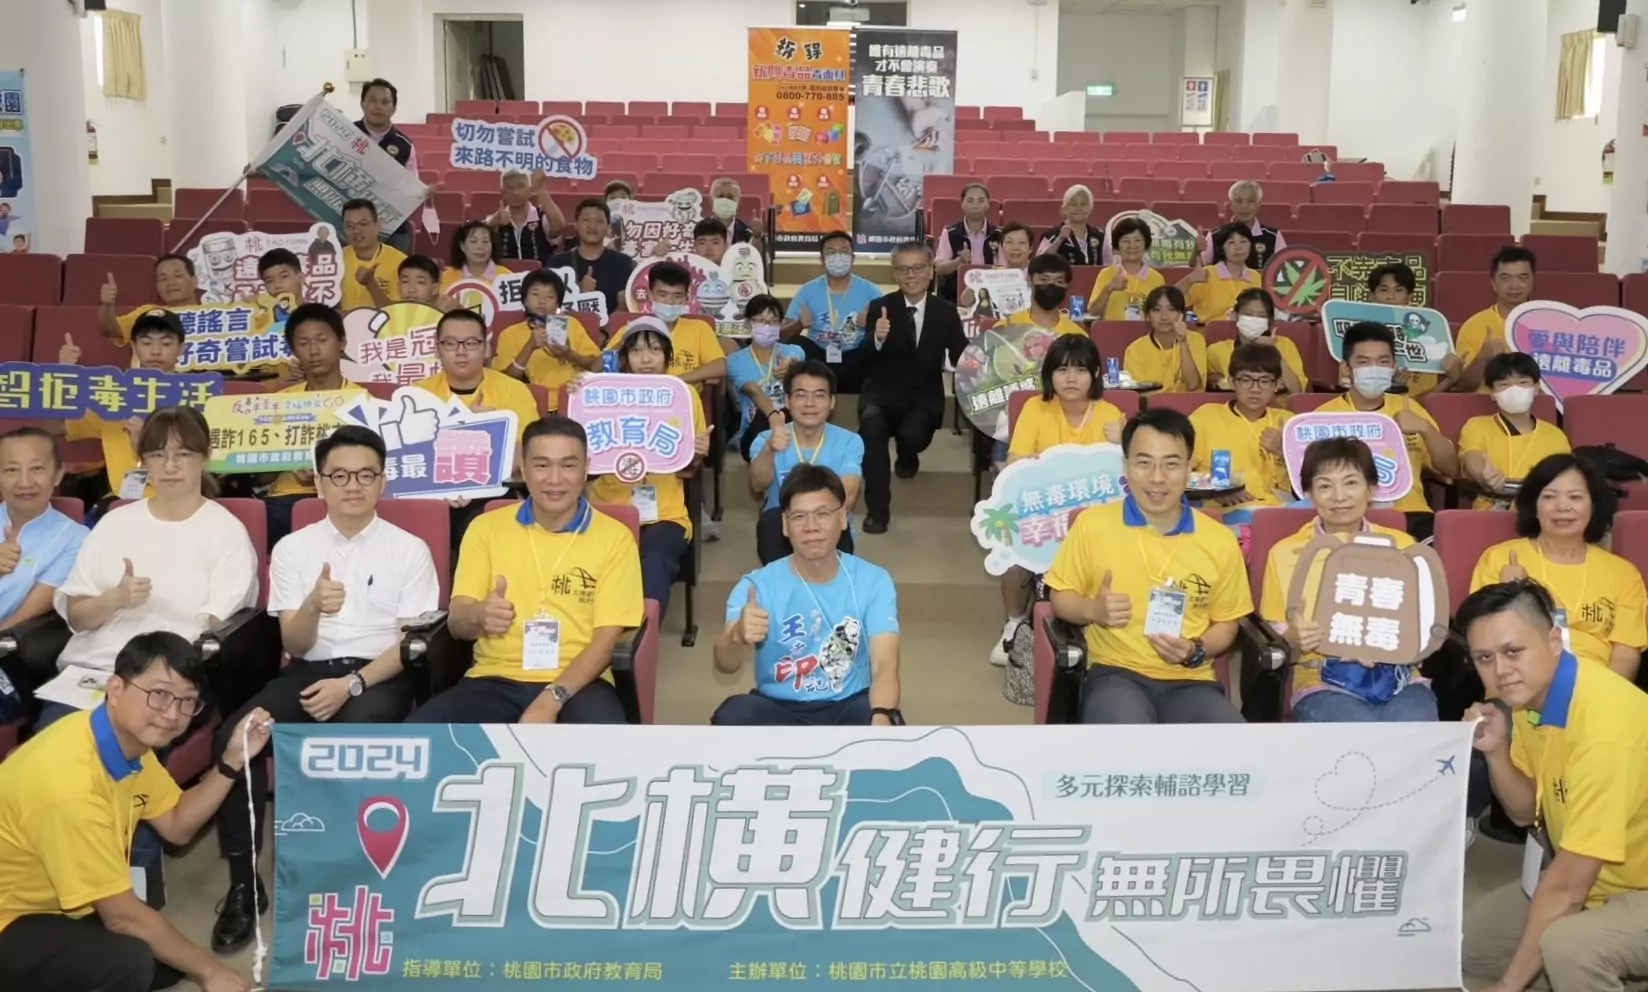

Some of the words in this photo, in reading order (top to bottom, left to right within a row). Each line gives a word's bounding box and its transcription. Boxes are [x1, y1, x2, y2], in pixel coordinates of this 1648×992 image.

[776, 91, 845, 101] 0800-770-885
[863, 75, 950, 98] 青春悲歌
[455, 123, 536, 148] 切勿嘗試
[455, 147, 594, 176] 來路不明的食物
[626, 221, 694, 239] 勿因好奇
[1528, 328, 1627, 358] 愛與陪伴
[1533, 352, 1612, 378] 遠離毒品
[584, 388, 671, 405] 桃園市政府
[209, 422, 340, 450] 遇詐165、打詐桃
[587, 416, 680, 456] 教育局
[1297, 424, 1382, 440] 桃園市政府
[1021, 474, 1115, 514] 無毒環境
[1334, 573, 1405, 611] 青春
[1328, 611, 1401, 651] 無毒
[308, 744, 422, 771] 2024
[1055, 773, 1251, 798] 多元探索輔諮學習
[1087, 851, 1408, 922] 無所畏懼
[304, 885, 395, 981] 桃
[402, 958, 663, 981] 指導單位：桃園市政府教育局
[728, 959, 1068, 981] 主辦單位：桃園市立桃園高級中等學校
